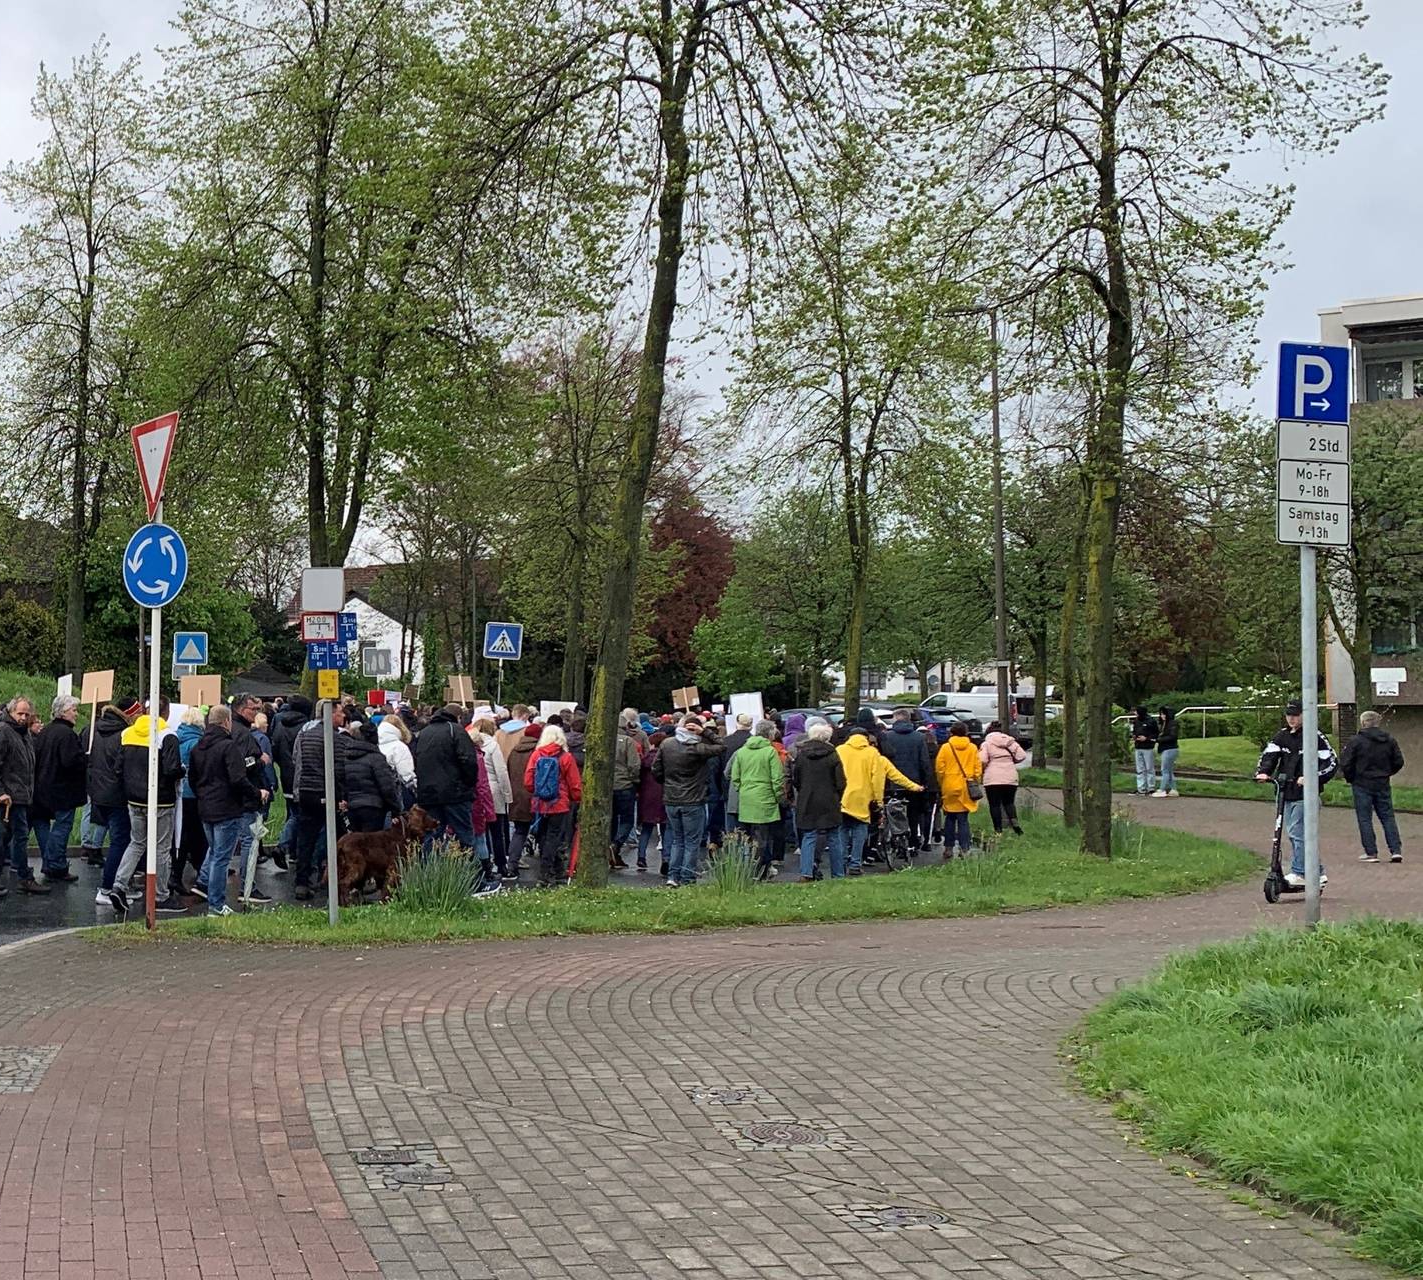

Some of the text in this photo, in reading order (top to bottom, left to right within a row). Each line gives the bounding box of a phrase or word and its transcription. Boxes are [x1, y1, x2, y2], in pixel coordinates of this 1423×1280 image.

[1294, 354, 1333, 417] P
[1309, 438, 1317, 451] 2
[1296, 467, 1333, 481] Mo-Fr
[1298, 484, 1329, 498] 9-18h
[1288, 507, 1339, 525] Samstag
[1298, 526, 1329, 540] 9-13h
